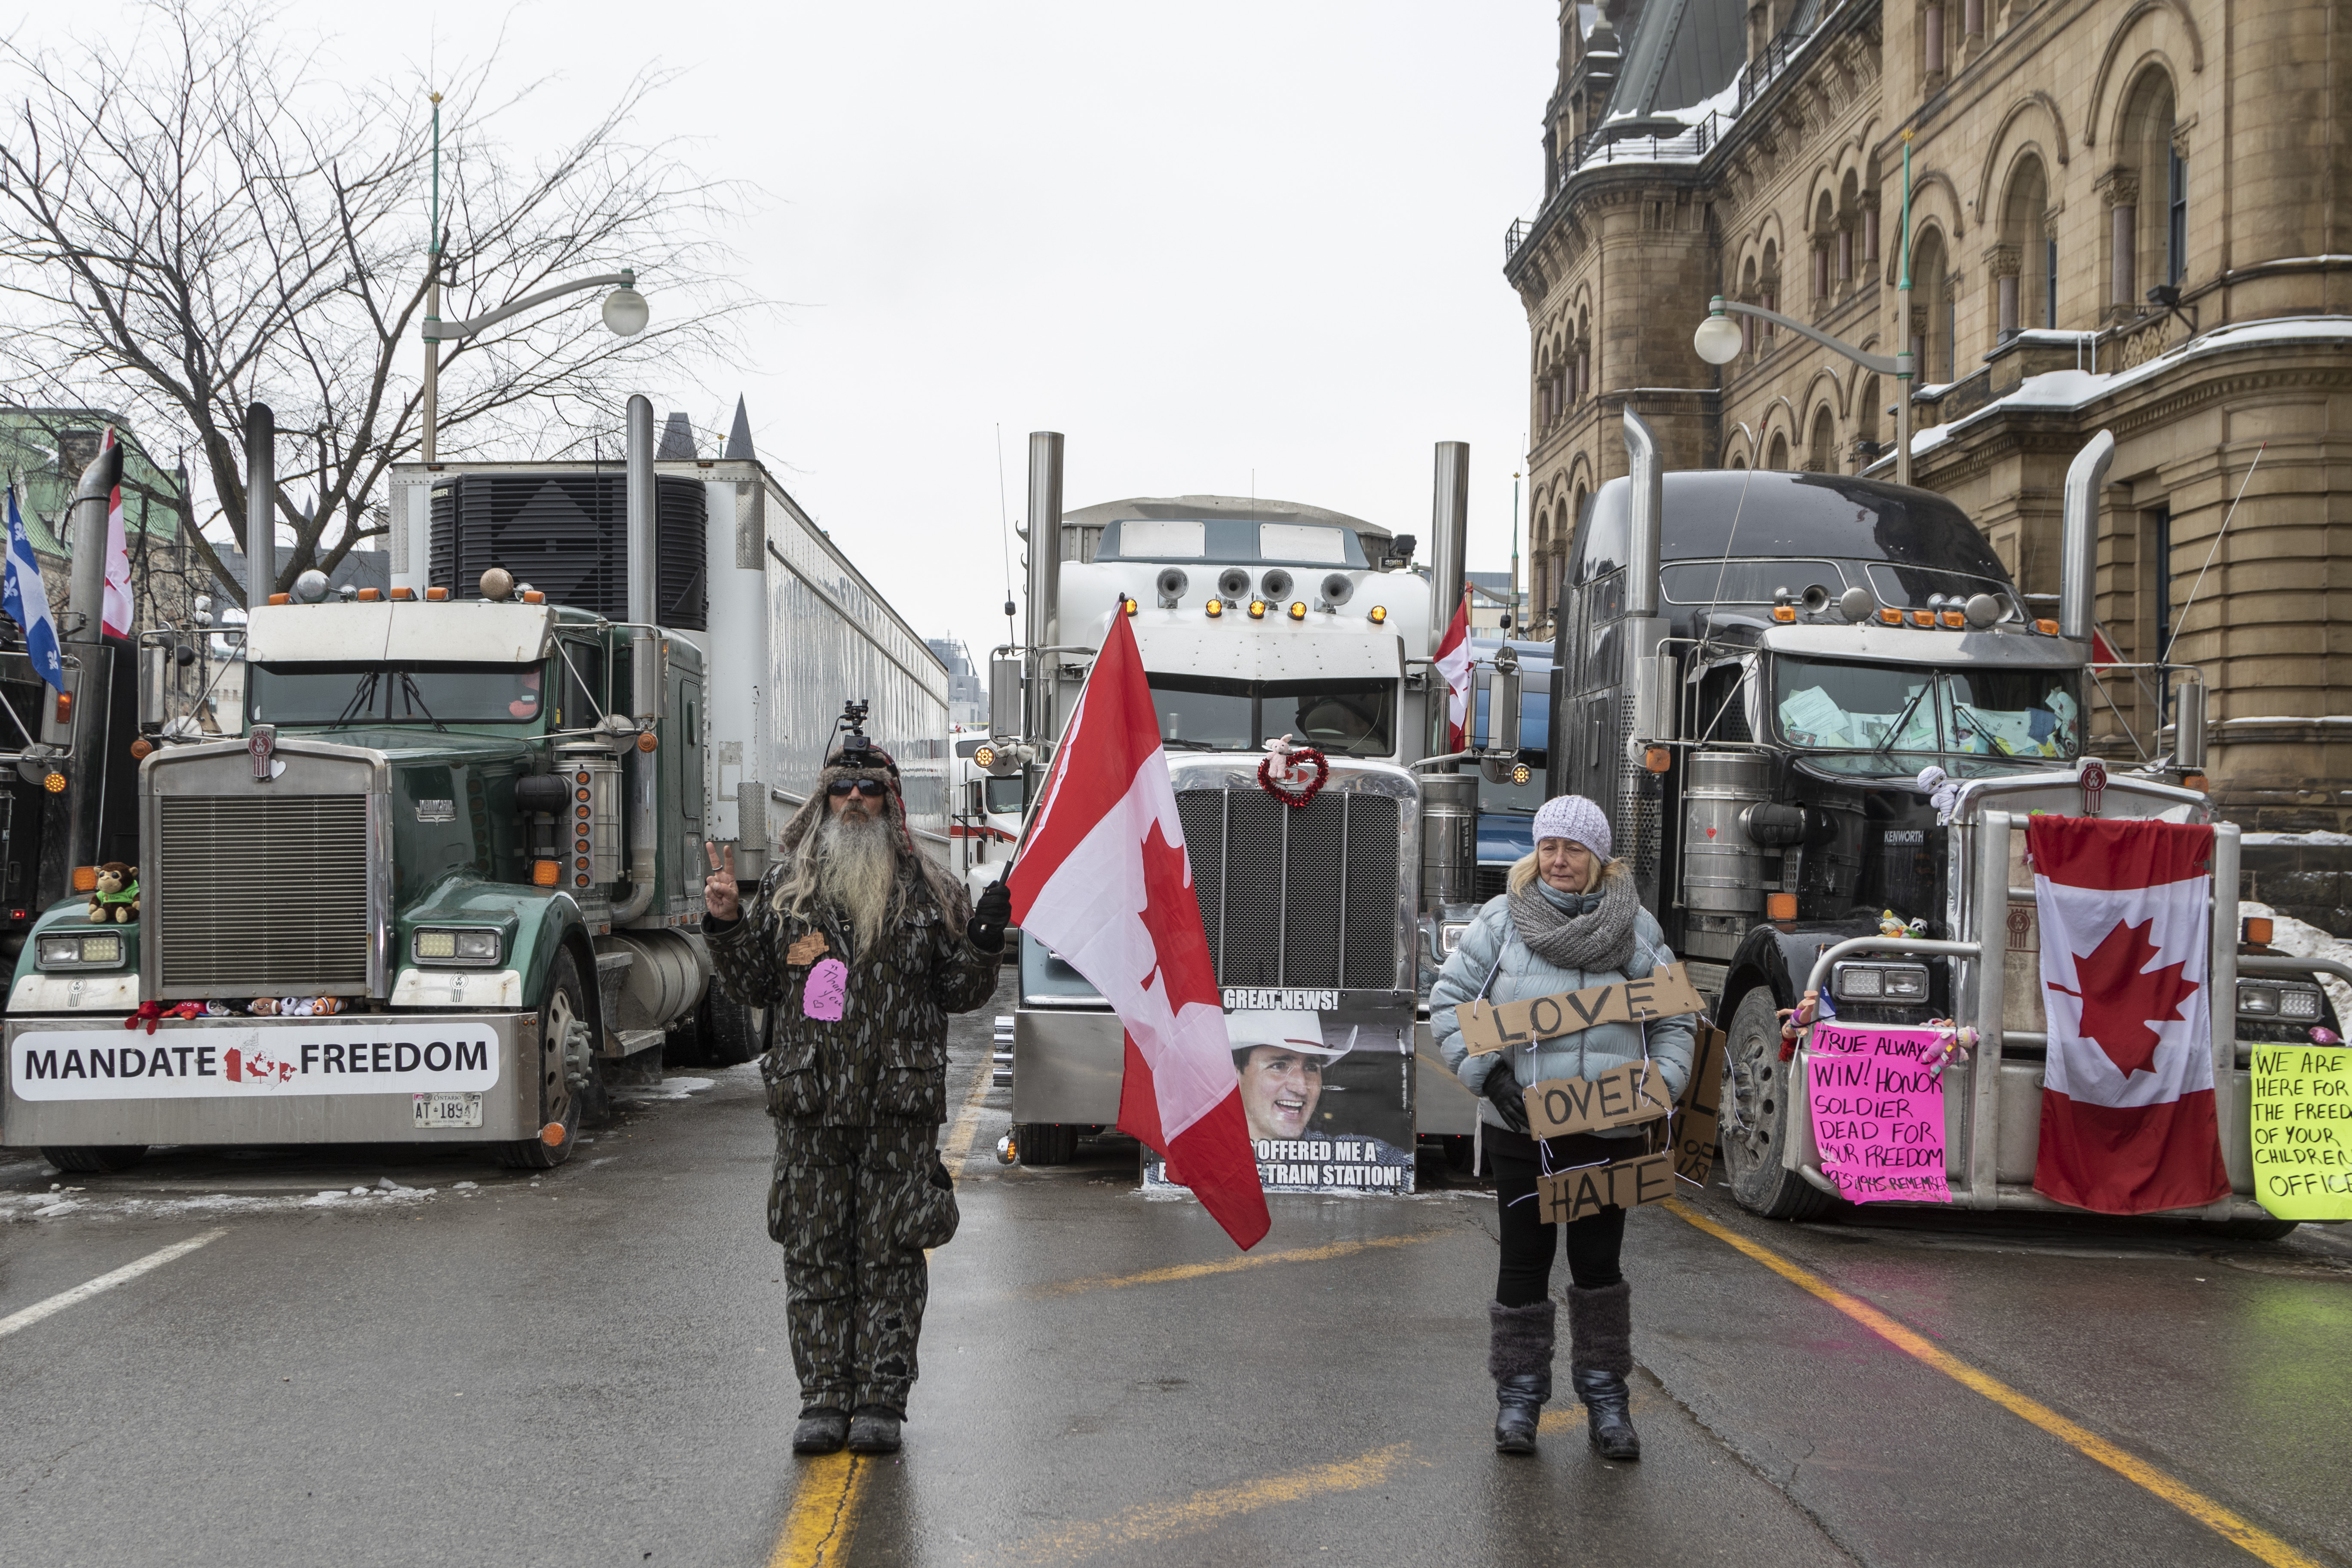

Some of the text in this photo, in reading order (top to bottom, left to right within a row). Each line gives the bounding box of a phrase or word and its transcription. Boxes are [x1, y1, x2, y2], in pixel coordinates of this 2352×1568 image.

[1884, 830, 1924, 842] KENWORTH
[1223, 989, 1338, 1011] GREAT NEWS!
[1492, 982, 1659, 1042] LOVE
[1817, 1029, 1867, 1053] TRUE
[25, 1041, 488, 1080] MANDATE FREEDOM
[2256, 1051, 2346, 1075] WE ARE
[1875, 1067, 1943, 1094] HONOR
[2257, 1078, 2349, 1097] HERE FOR
[1544, 1068, 1668, 1125] OVER
[415, 1102, 431, 1118] AT
[2253, 1102, 2352, 1121] THE FREED
[1820, 1121, 1937, 1144] DEAD FOR
[2255, 1126, 2342, 1147] OF YOUR
[1258, 1140, 1331, 1161] OFFERED
[1335, 1141, 1361, 1161] ME
[1362, 1142, 1376, 1161] A
[1821, 1142, 1943, 1168] YOUR FREEDOM
[1268, 1164, 1319, 1185] TRAIN
[1323, 1165, 1402, 1186] STATION!
[1889, 1175, 1951, 1192] REMEMBER
[1549, 1157, 1673, 1221] HATE
